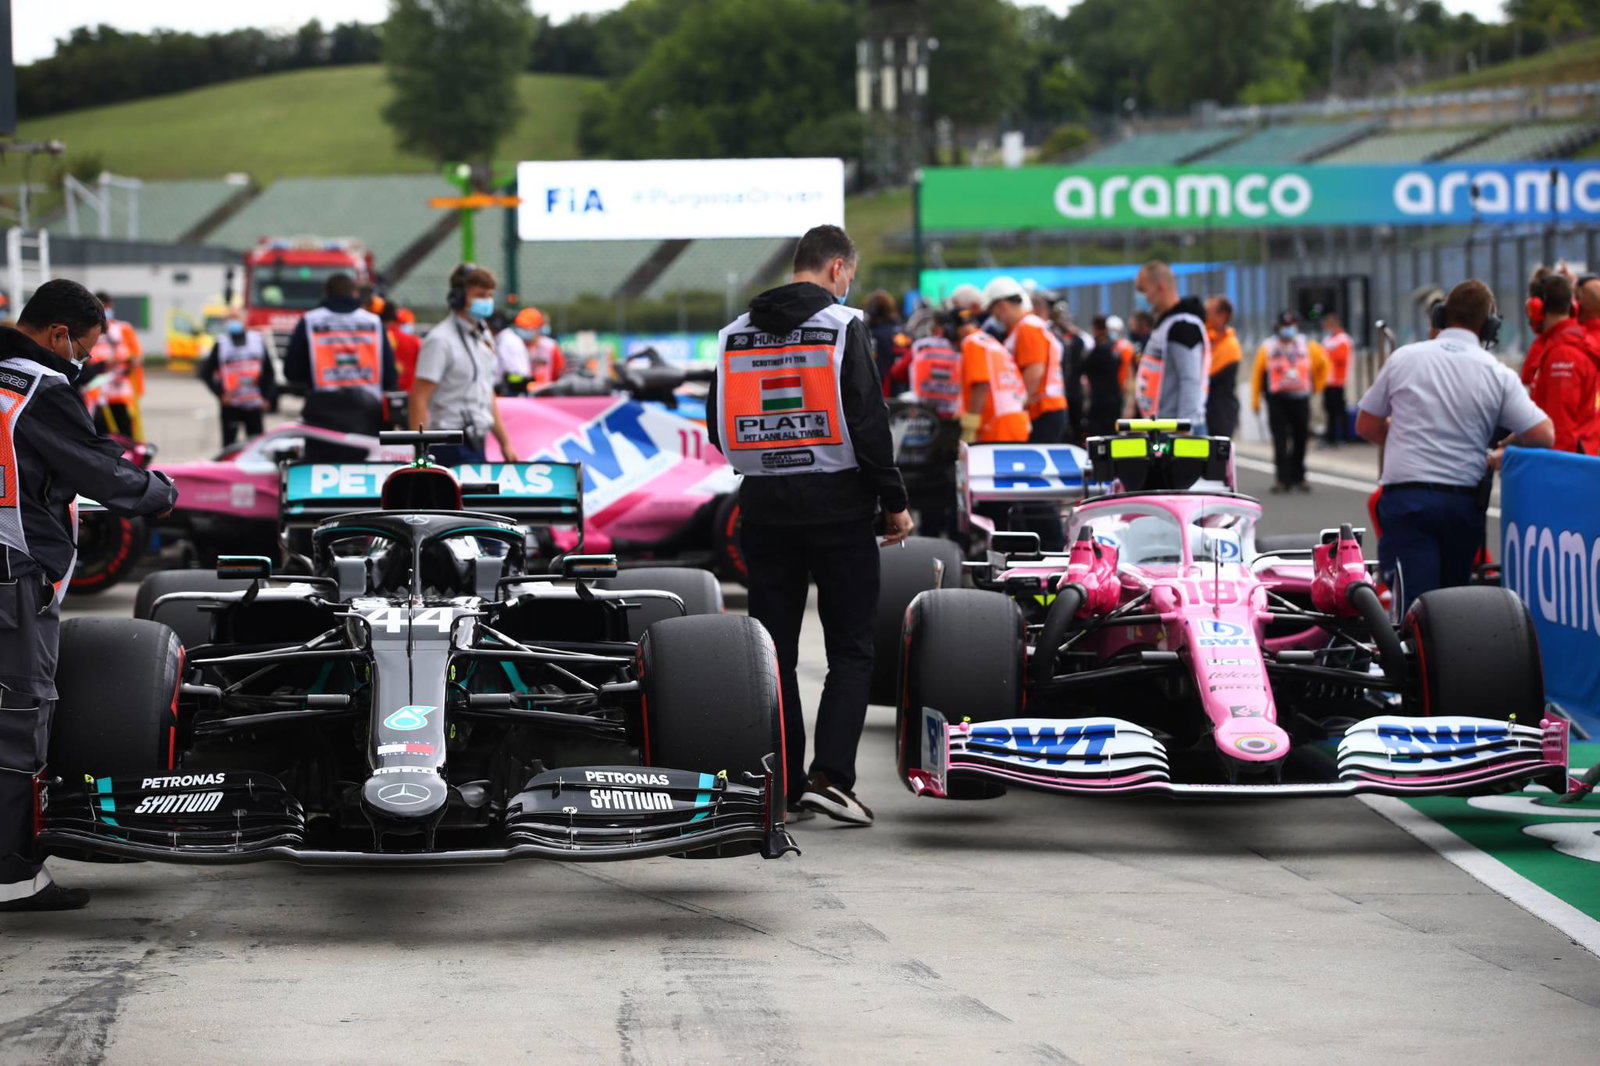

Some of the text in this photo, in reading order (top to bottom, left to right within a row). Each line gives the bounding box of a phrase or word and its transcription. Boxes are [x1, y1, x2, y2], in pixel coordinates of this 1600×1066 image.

[1053, 174, 1313, 219] aramco
[739, 415, 811, 432] PLAT
[759, 432, 781, 441] LANE
[782, 431, 799, 439] ALL
[799, 429, 824, 439] TIMES
[531, 400, 661, 494] WT
[677, 428, 703, 459] 11
[311, 464, 554, 494] PETNAS
[1504, 521, 1600, 637] aram
[1180, 580, 1239, 605] 18
[366, 608, 453, 633] 44
[1199, 638, 1252, 646] BWT
[967, 723, 1115, 766] BWT
[1376, 722, 1511, 764] BWT
[141, 772, 225, 789] PETRONAS
[585, 770, 670, 786] PETRONAS
[134, 791, 224, 814] SYNTIUM
[589, 789, 674, 810] SYNTIUM
